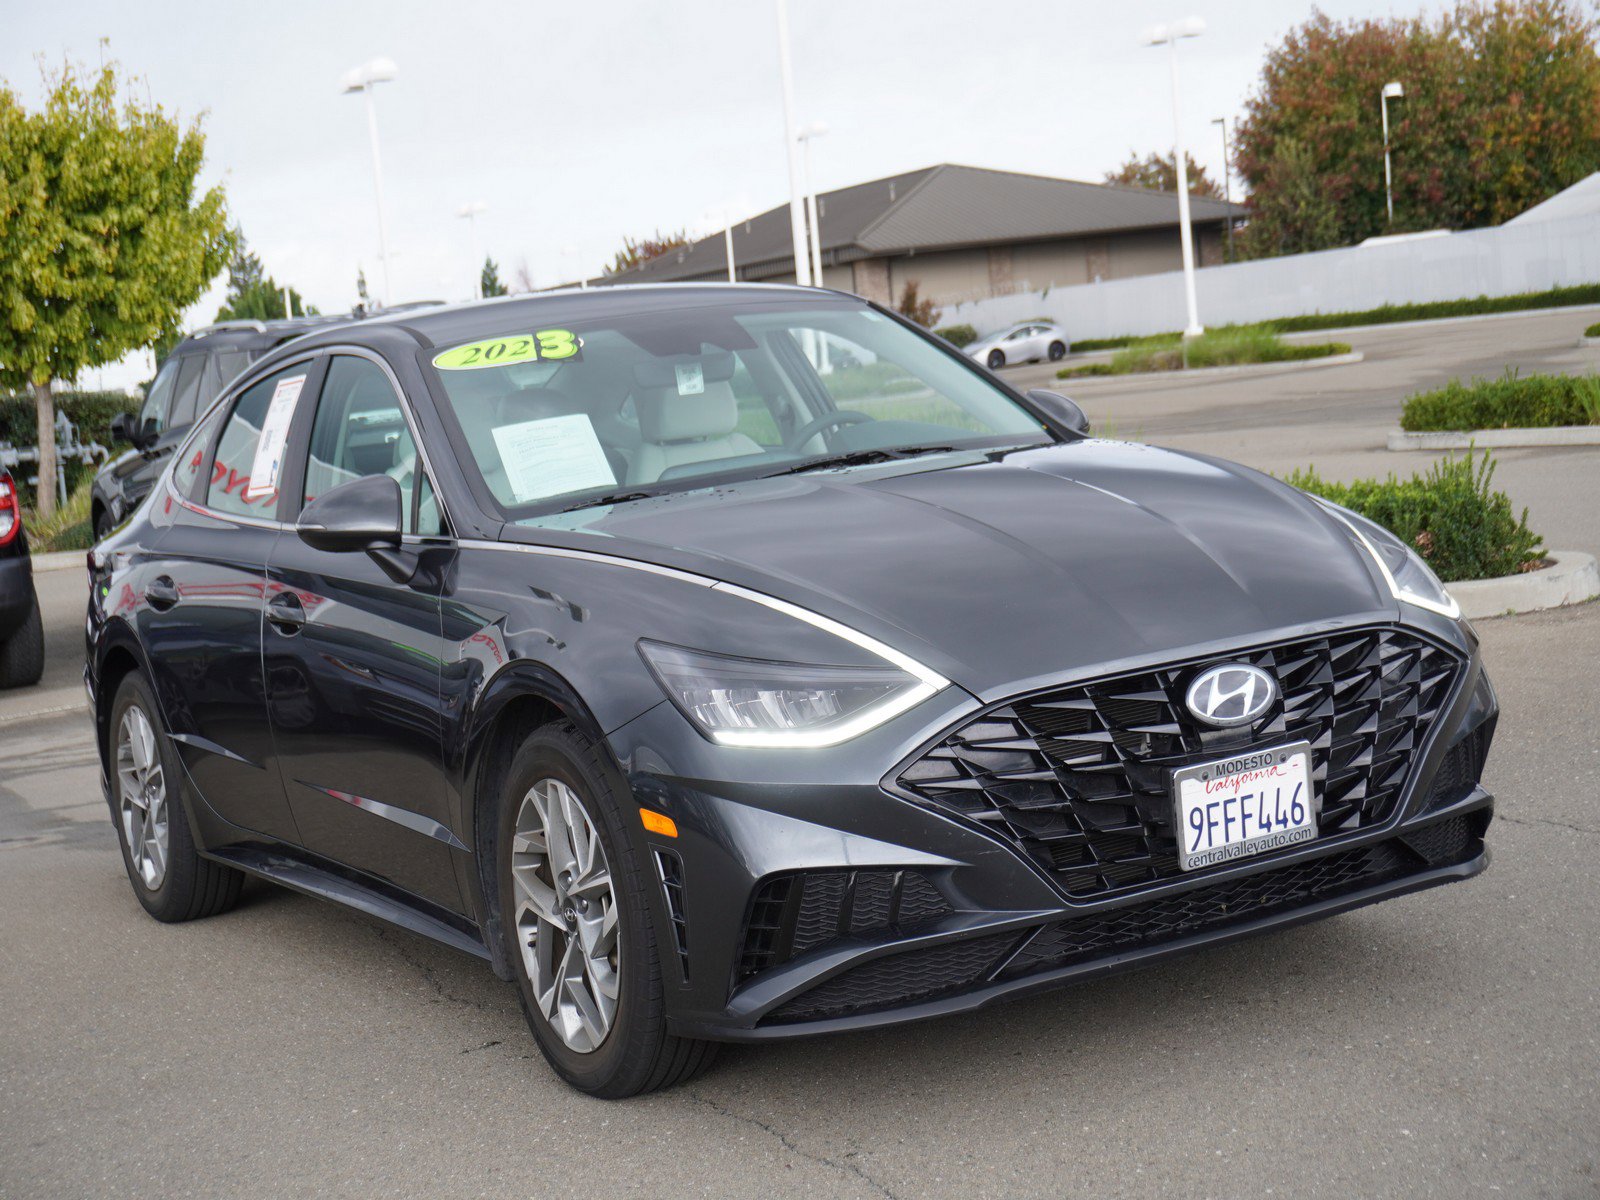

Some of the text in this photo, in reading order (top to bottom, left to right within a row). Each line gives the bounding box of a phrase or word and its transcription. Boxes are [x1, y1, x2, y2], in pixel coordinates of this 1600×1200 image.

[1205, 765, 1287, 794] California
[1215, 753, 1273, 777] MODESTO
[1189, 781, 1304, 852] 9FFF446
[1188, 827, 1312, 868] centralvalleyauto.com
